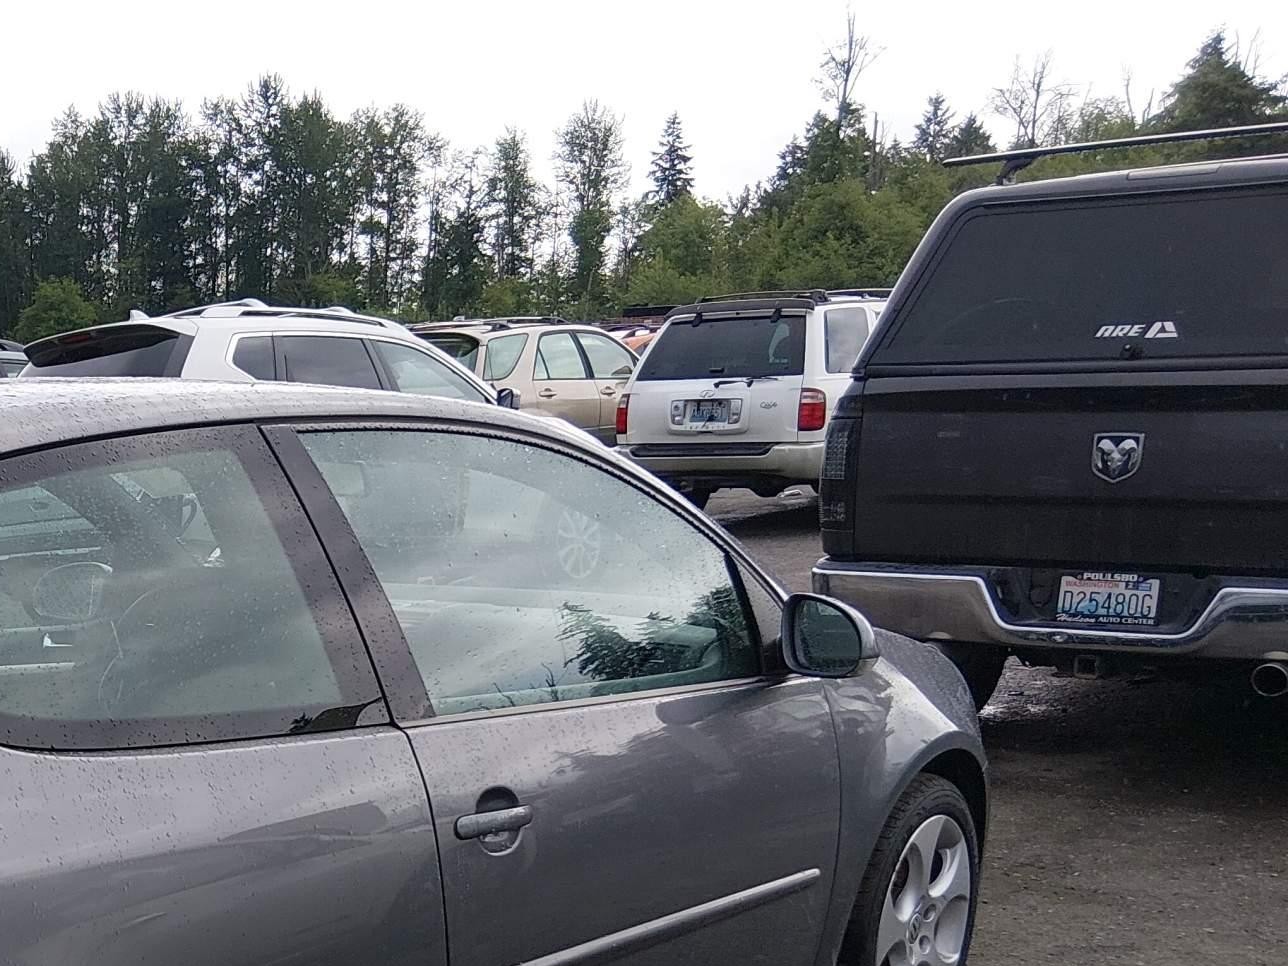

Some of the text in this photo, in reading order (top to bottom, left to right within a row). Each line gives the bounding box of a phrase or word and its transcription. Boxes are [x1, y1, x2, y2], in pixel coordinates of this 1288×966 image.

[1083, 572, 1138, 582] POULSBO
[1065, 580, 1120, 589] WASHINGTON
[1062, 590, 1153, 618] D25480G
